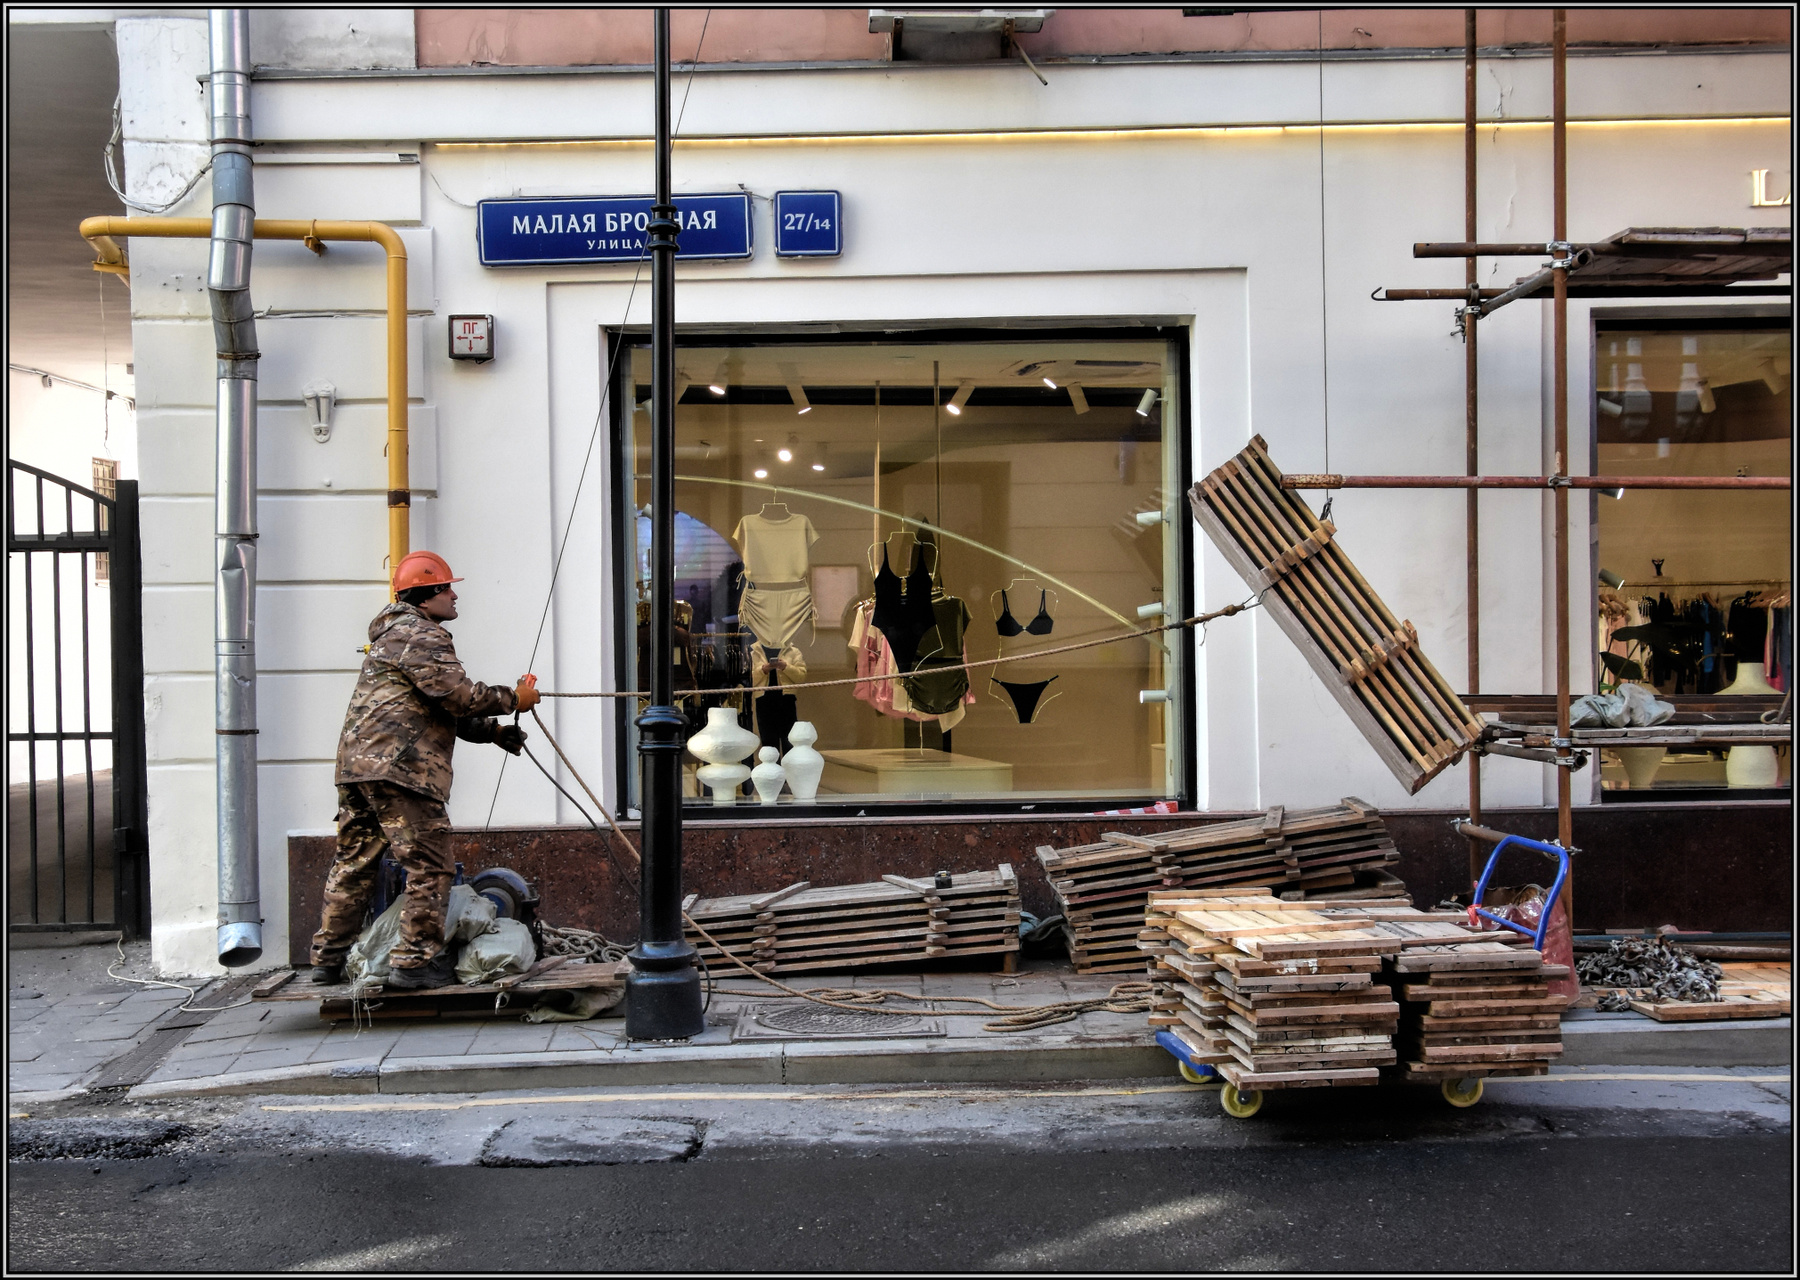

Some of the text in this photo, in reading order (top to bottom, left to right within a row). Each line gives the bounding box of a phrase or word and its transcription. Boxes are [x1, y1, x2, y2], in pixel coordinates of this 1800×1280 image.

[1752, 169, 1790, 206] L
[512, 210, 717, 235] МАЛАЯ БРОНАЯ
[784, 212, 831, 232] 27/14
[587, 238, 643, 250] УЛИЦА
[463, 321, 478, 334] ПГ
